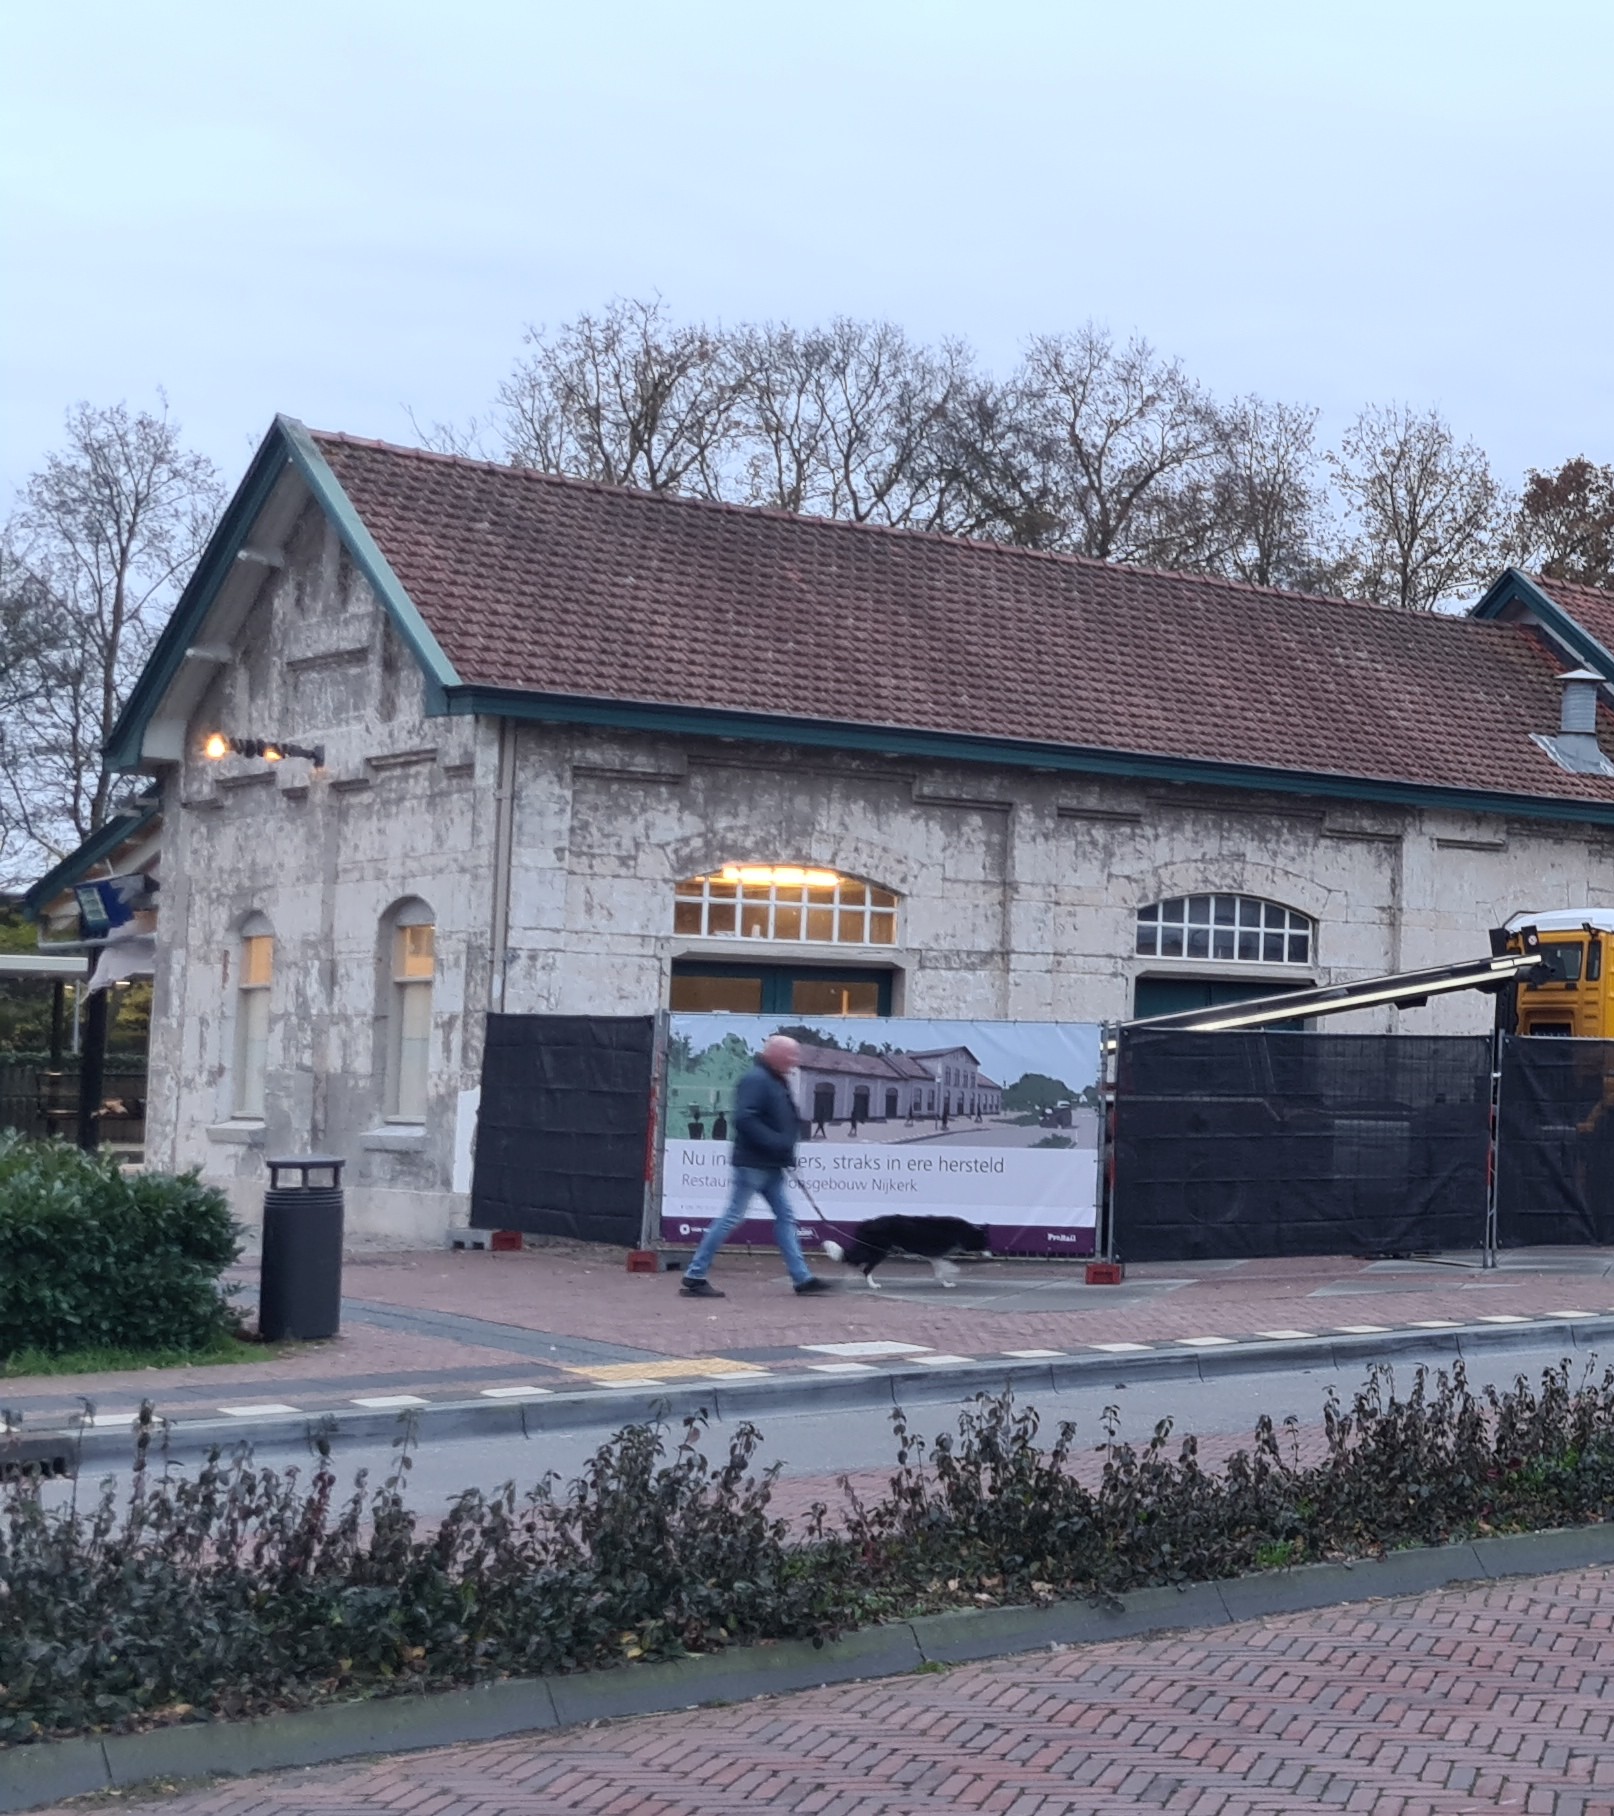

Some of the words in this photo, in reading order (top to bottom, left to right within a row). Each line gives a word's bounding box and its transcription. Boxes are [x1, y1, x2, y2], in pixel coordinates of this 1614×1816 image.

[682, 1150, 705, 1166] Nu
[711, 1152, 727, 1167] in
[833, 1154, 881, 1171] straks
[886, 1156, 901, 1171] in
[907, 1158, 933, 1172] ere
[938, 1156, 1004, 1174] hersteld
[871, 1178, 918, 1195] Nijkerk
[1047, 1232, 1077, 1242] ProRail
